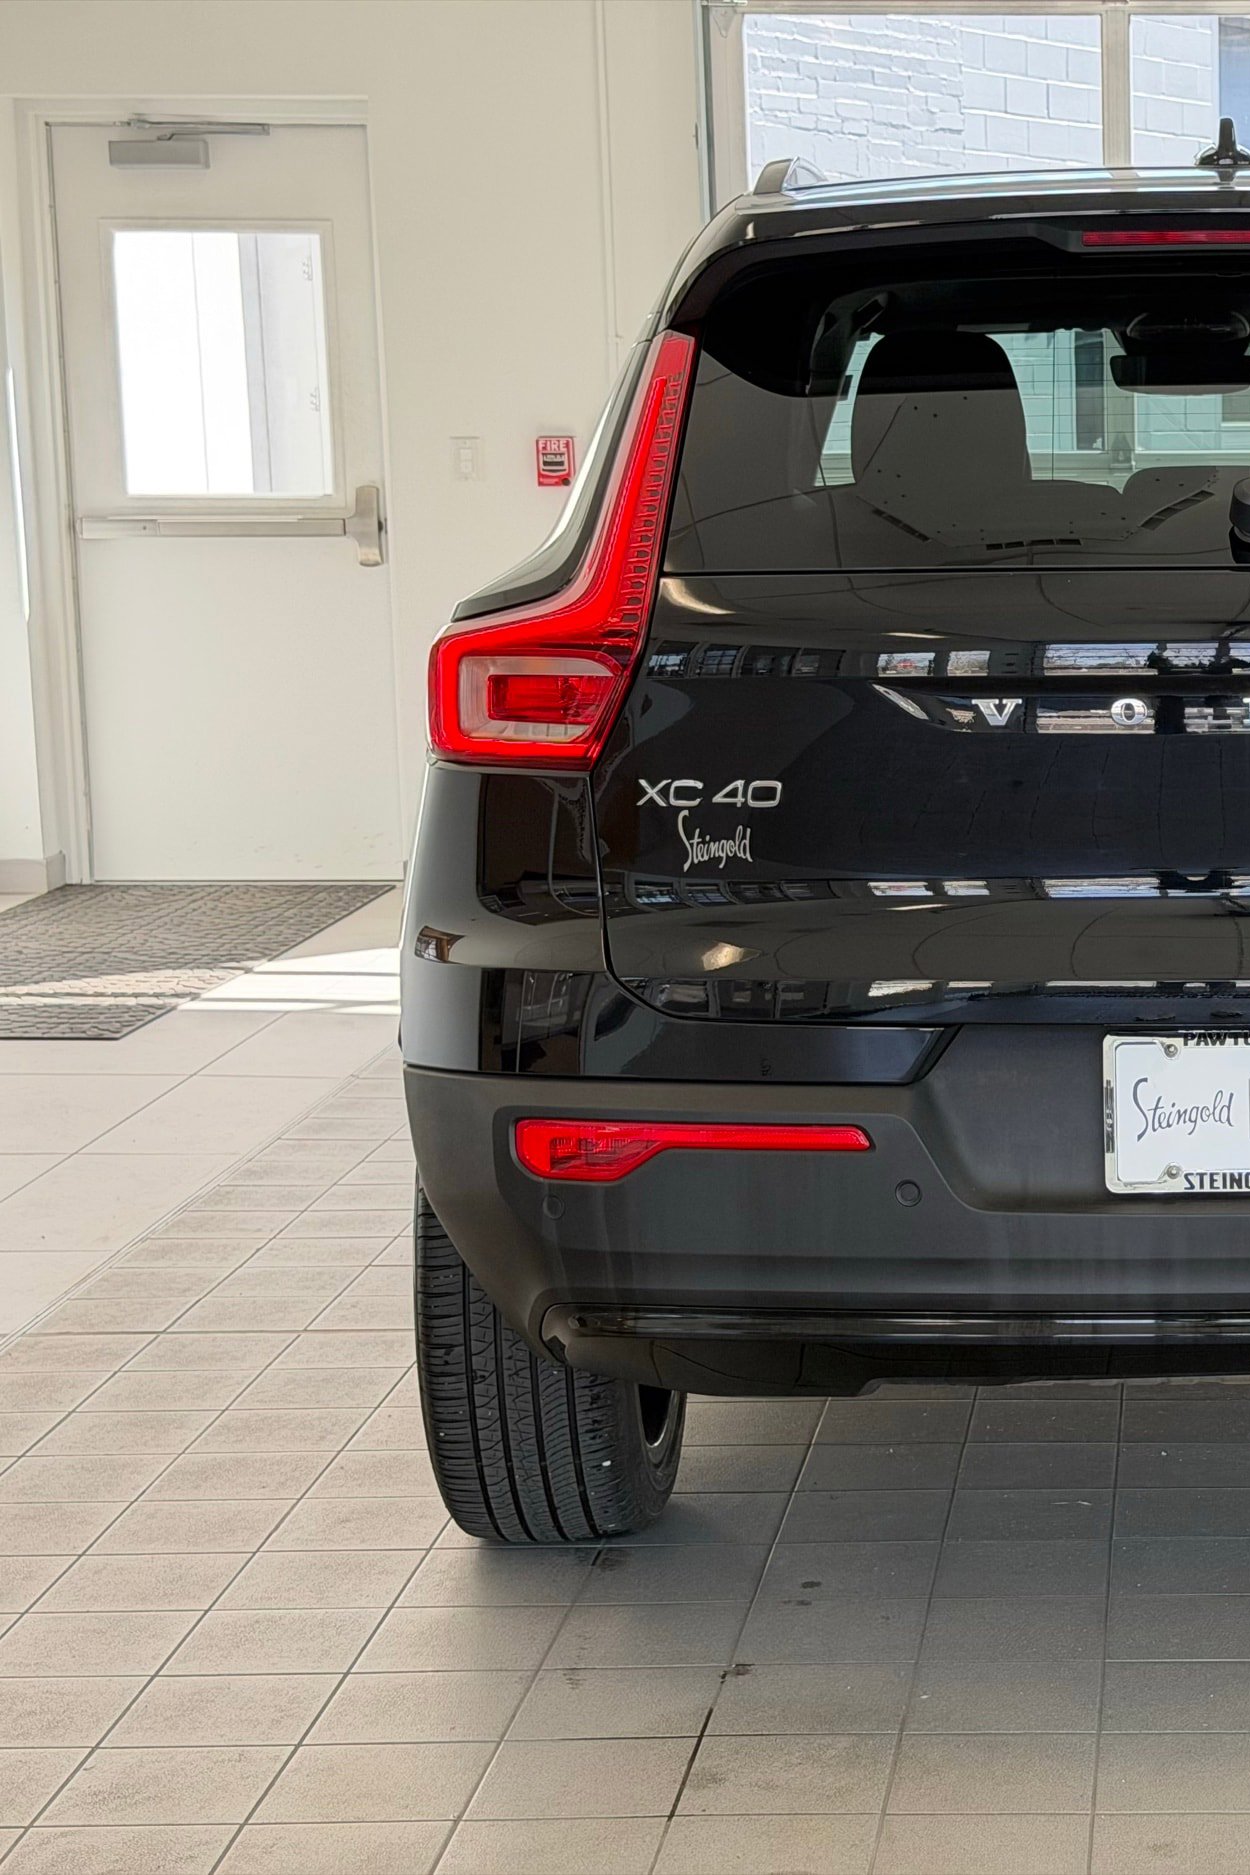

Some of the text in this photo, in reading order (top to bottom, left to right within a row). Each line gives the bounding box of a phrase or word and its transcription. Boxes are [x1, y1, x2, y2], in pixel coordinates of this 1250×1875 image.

[538, 439, 568, 451] FIRE
[677, 809, 753, 872] Steingold
[1131, 1077, 1235, 1142] Steingold
